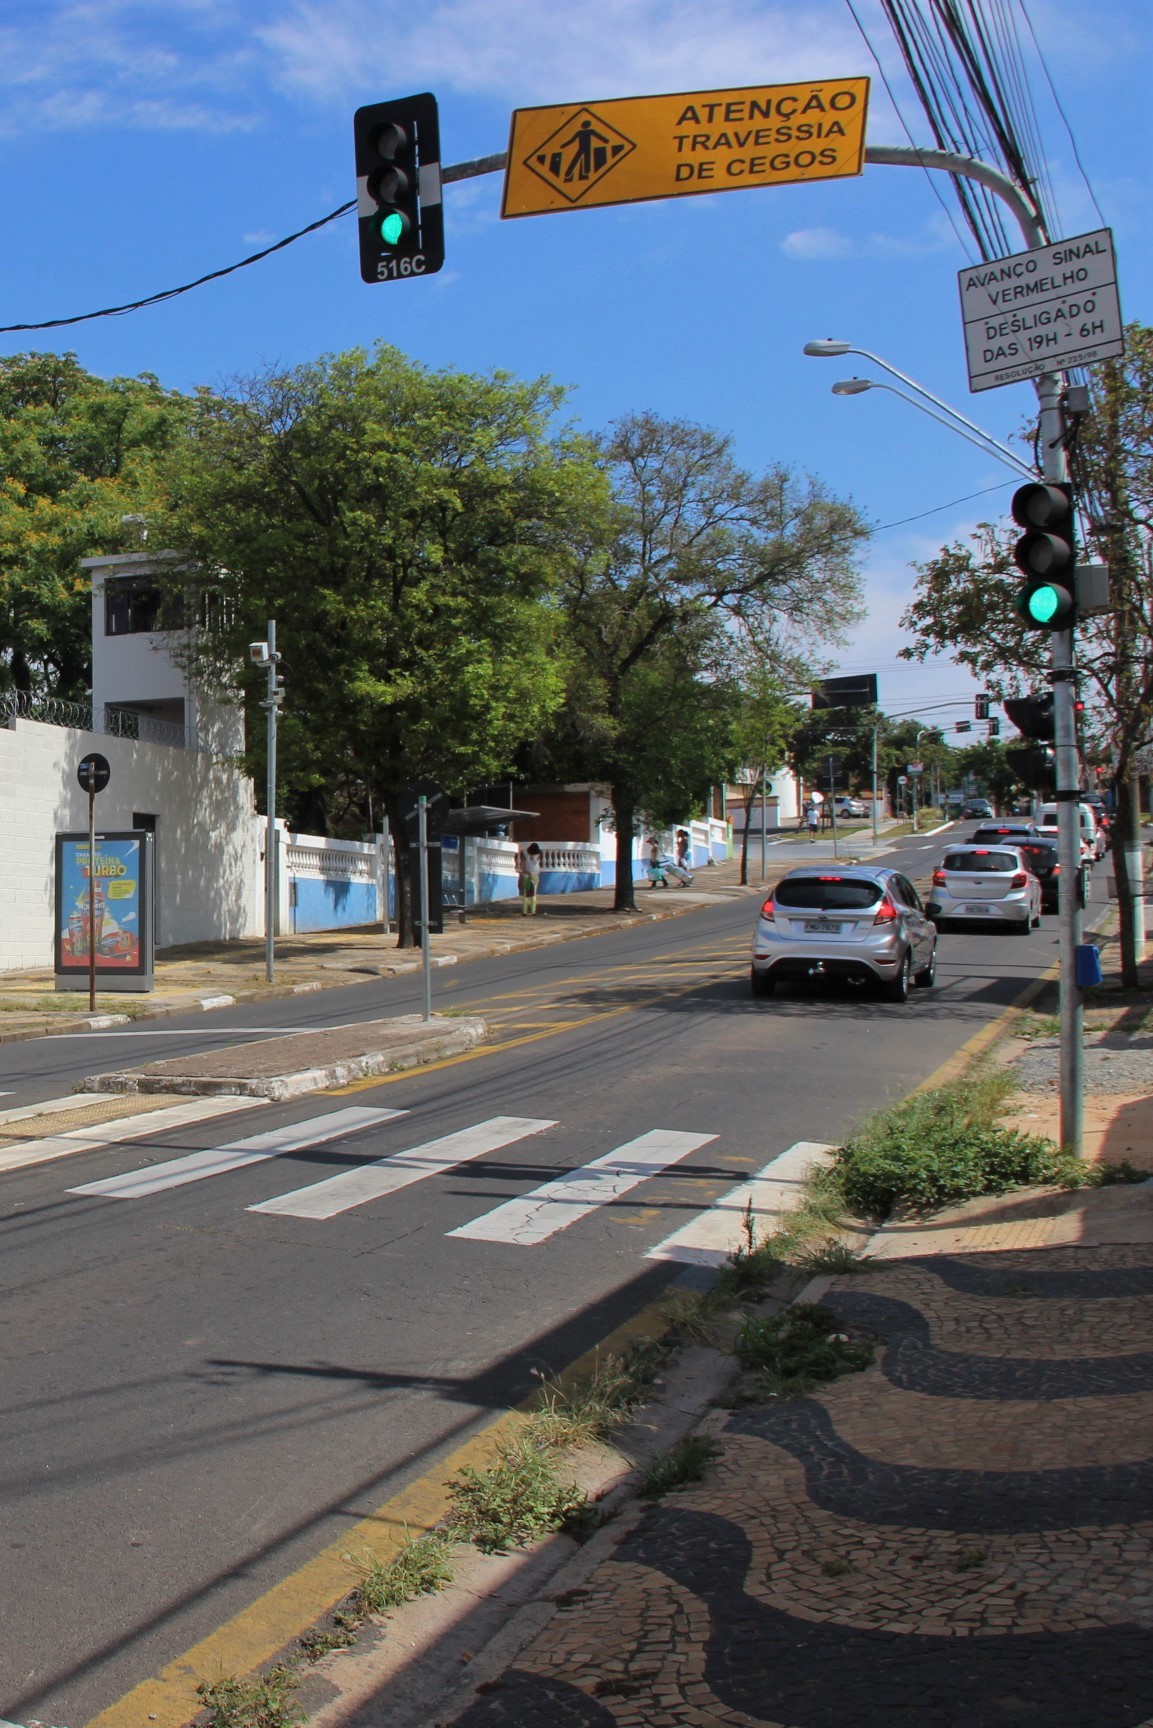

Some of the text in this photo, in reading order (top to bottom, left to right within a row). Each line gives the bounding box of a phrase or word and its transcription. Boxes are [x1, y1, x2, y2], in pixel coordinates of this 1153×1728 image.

[675, 88, 857, 127] ATENÇÃO
[672, 120, 846, 153] TRAVESSIA
[674, 147, 838, 182] DE CEGOS
[376, 254, 426, 280] 516C
[965, 240, 1107, 292] AVANÇO SINAL
[987, 267, 1089, 306] VERMELHO
[985, 299, 1097, 341] DESLIGADO
[983, 342, 1019, 363] DAS
[1027, 331, 1058, 352] 19H
[1079, 319, 1105, 338] 6H
[994, 362, 1046, 382] RESOLUÇÃO
[76, 854, 121, 865] PRTEÍNA
